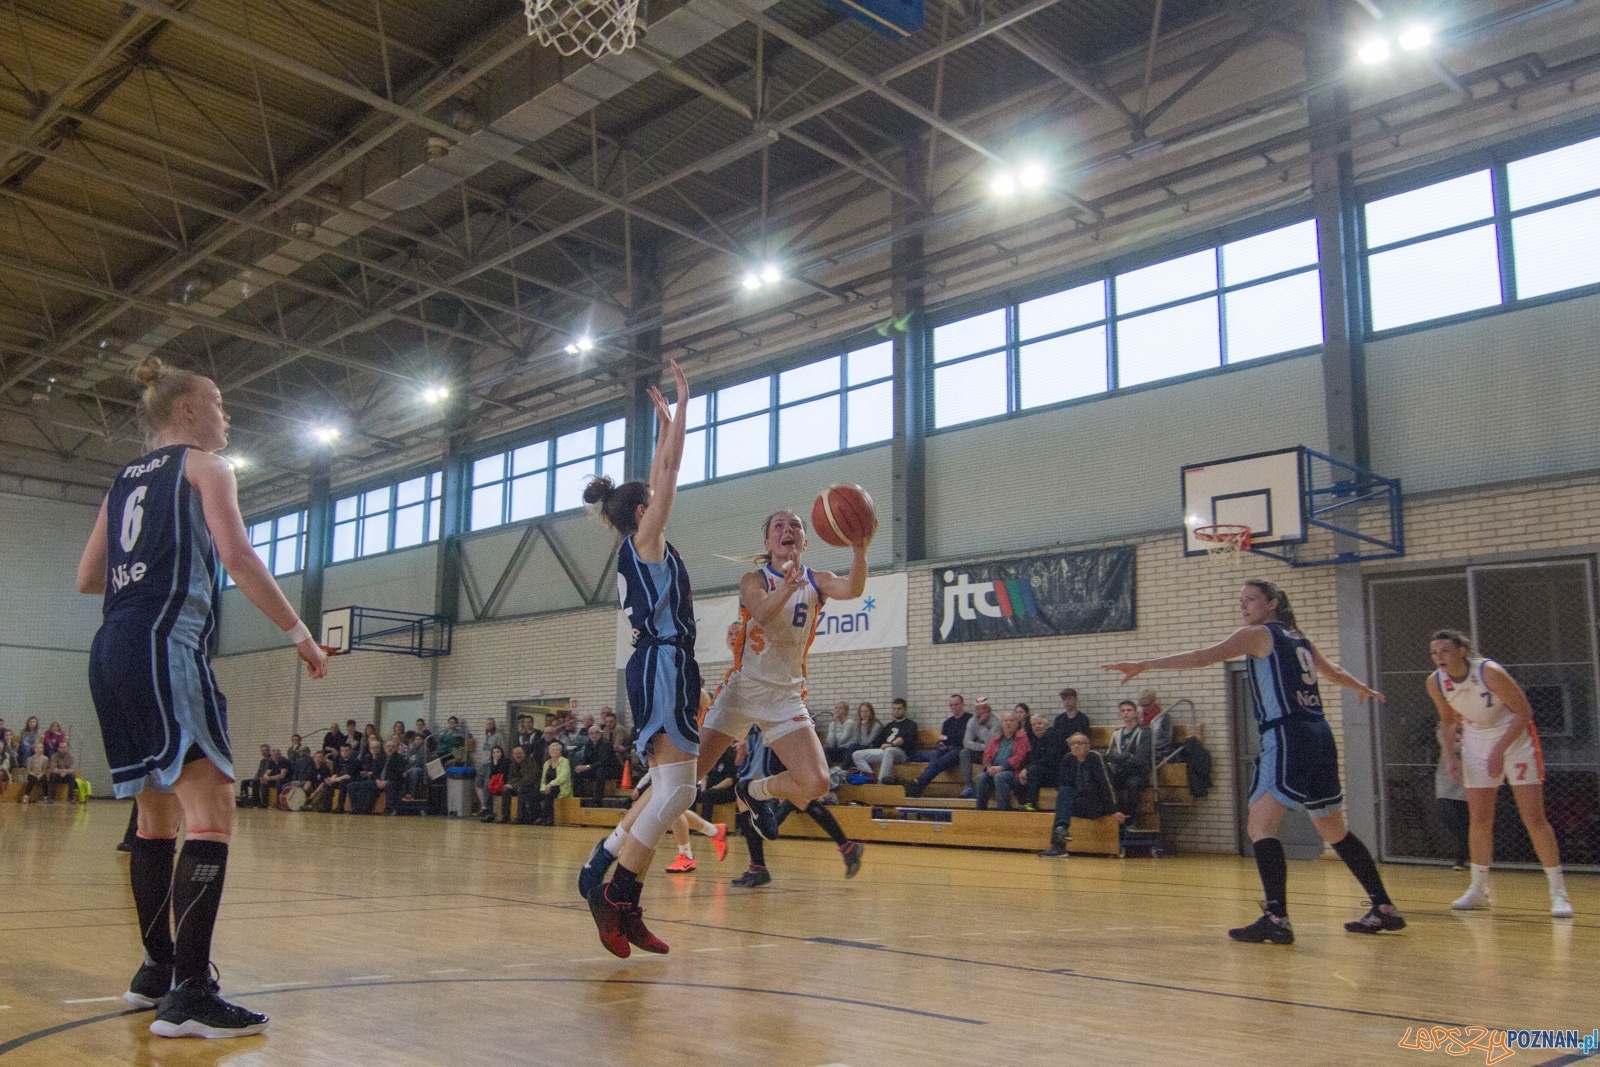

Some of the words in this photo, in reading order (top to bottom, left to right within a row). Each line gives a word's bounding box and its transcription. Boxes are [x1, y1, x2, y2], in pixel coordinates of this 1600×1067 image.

[120, 485, 148, 553] 6
[792, 602, 808, 628] 6
[939, 570, 1003, 641] jtc
[1295, 646, 1318, 685] 9
[1480, 691, 1494, 708] 7
[1514, 762, 1529, 781] 7
